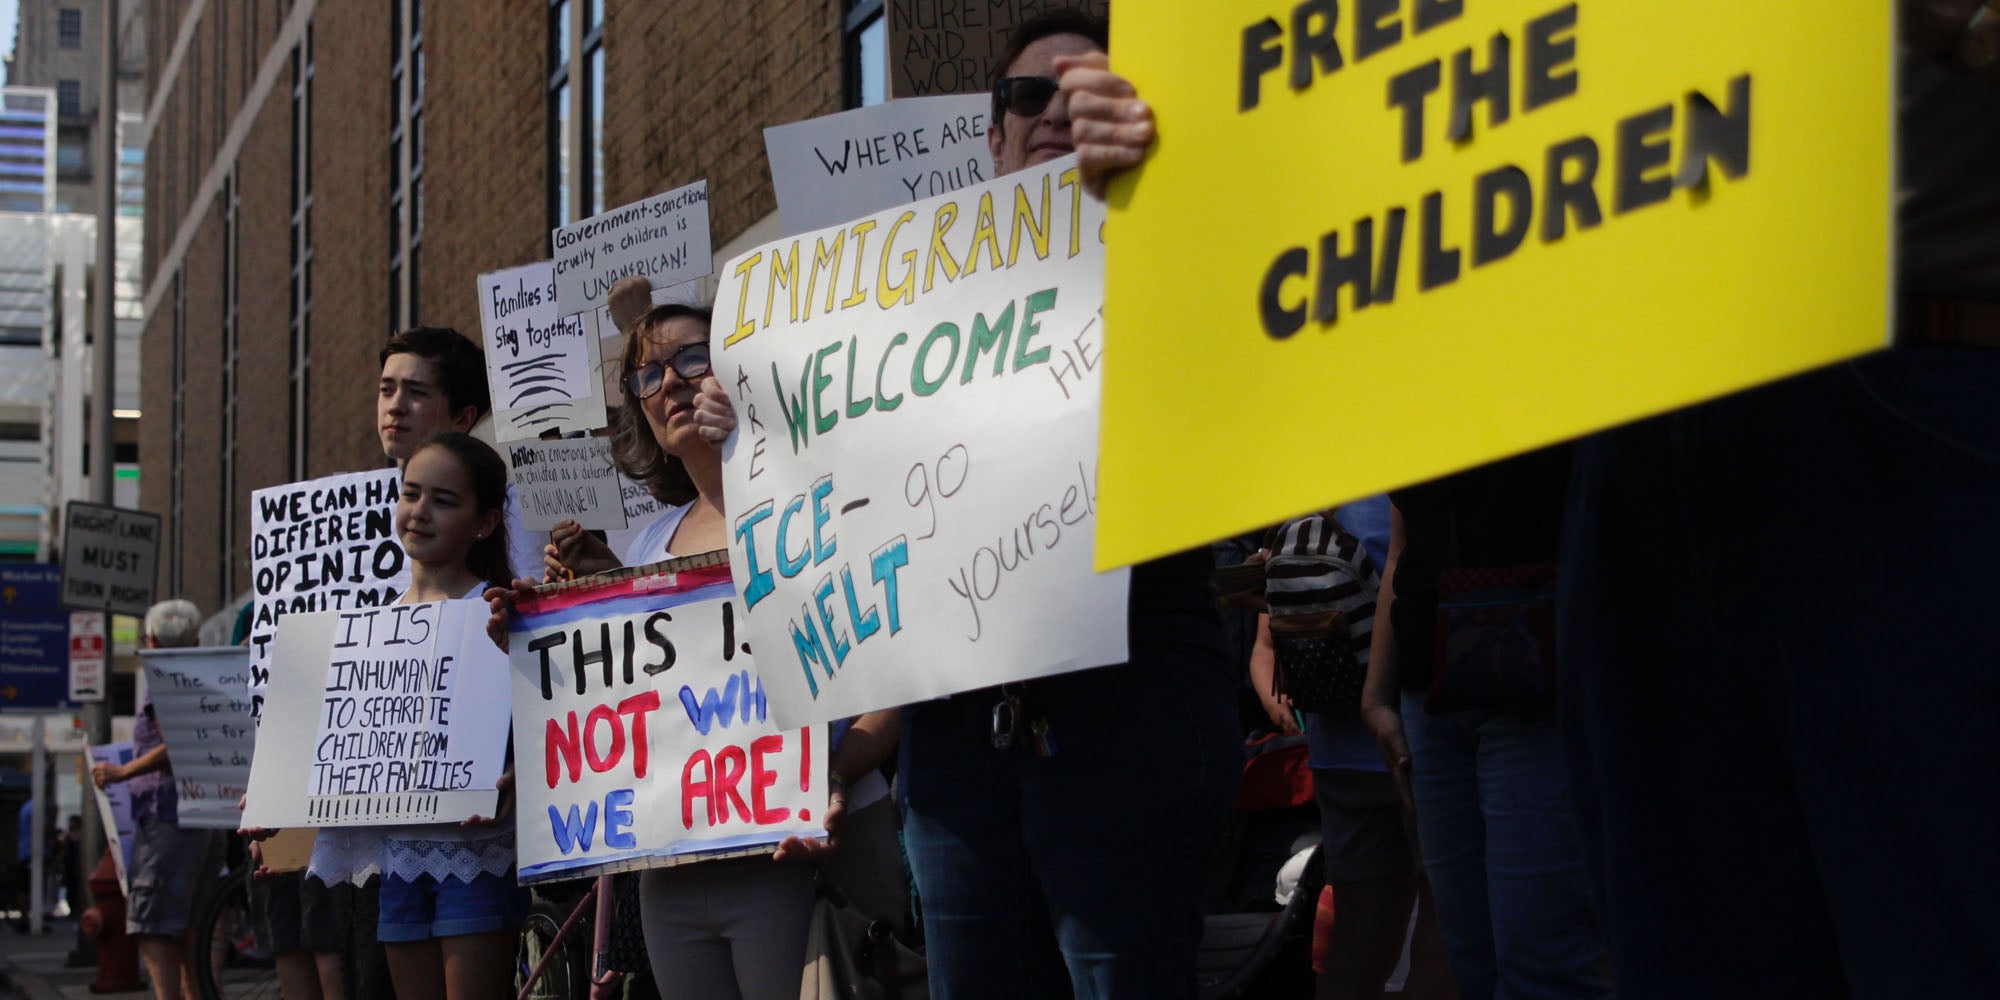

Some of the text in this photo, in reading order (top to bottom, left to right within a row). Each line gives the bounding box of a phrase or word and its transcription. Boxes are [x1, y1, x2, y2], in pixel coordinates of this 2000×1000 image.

[905, 31, 964, 60] AND
[1387, 2, 1578, 165] THE
[814, 114, 985, 176] WHERE ARE
[902, 158, 984, 201] YOUR
[1258, 73, 1751, 341] CHILDREN
[556, 214, 687, 275] cruelty to children is
[723, 167, 1106, 350] IMMIGRANT
[492, 277, 542, 319] Families
[526, 312, 584, 349] together!
[1049, 304, 1104, 400] HE
[772, 287, 1058, 456] WELCOME
[526, 467, 558, 485] children
[561, 468, 571, 481] as
[549, 444, 588, 465] emotional
[260, 477, 400, 523] WE CAN HA
[622, 485, 650, 500] ESUS
[905, 444, 969, 541] go
[255, 507, 392, 560] DIFFEREN
[82, 546, 140, 573] MUST
[256, 540, 405, 596] OPINIO
[789, 461, 1095, 701] MELT yoursel
[334, 603, 433, 648] IT IS
[528, 601, 751, 700] THIS I
[218, 671, 249, 693] only
[325, 656, 454, 694] INHUMANE
[222, 724, 246, 738] for
[325, 695, 451, 729] TO SEPARATE
[545, 669, 767, 789] NOT WH
[317, 730, 449, 762] CHILDREN FROM
[182, 776, 206, 801] No
[314, 759, 474, 796] THEIR FAMILIES
[548, 726, 811, 855] WE ARE!
